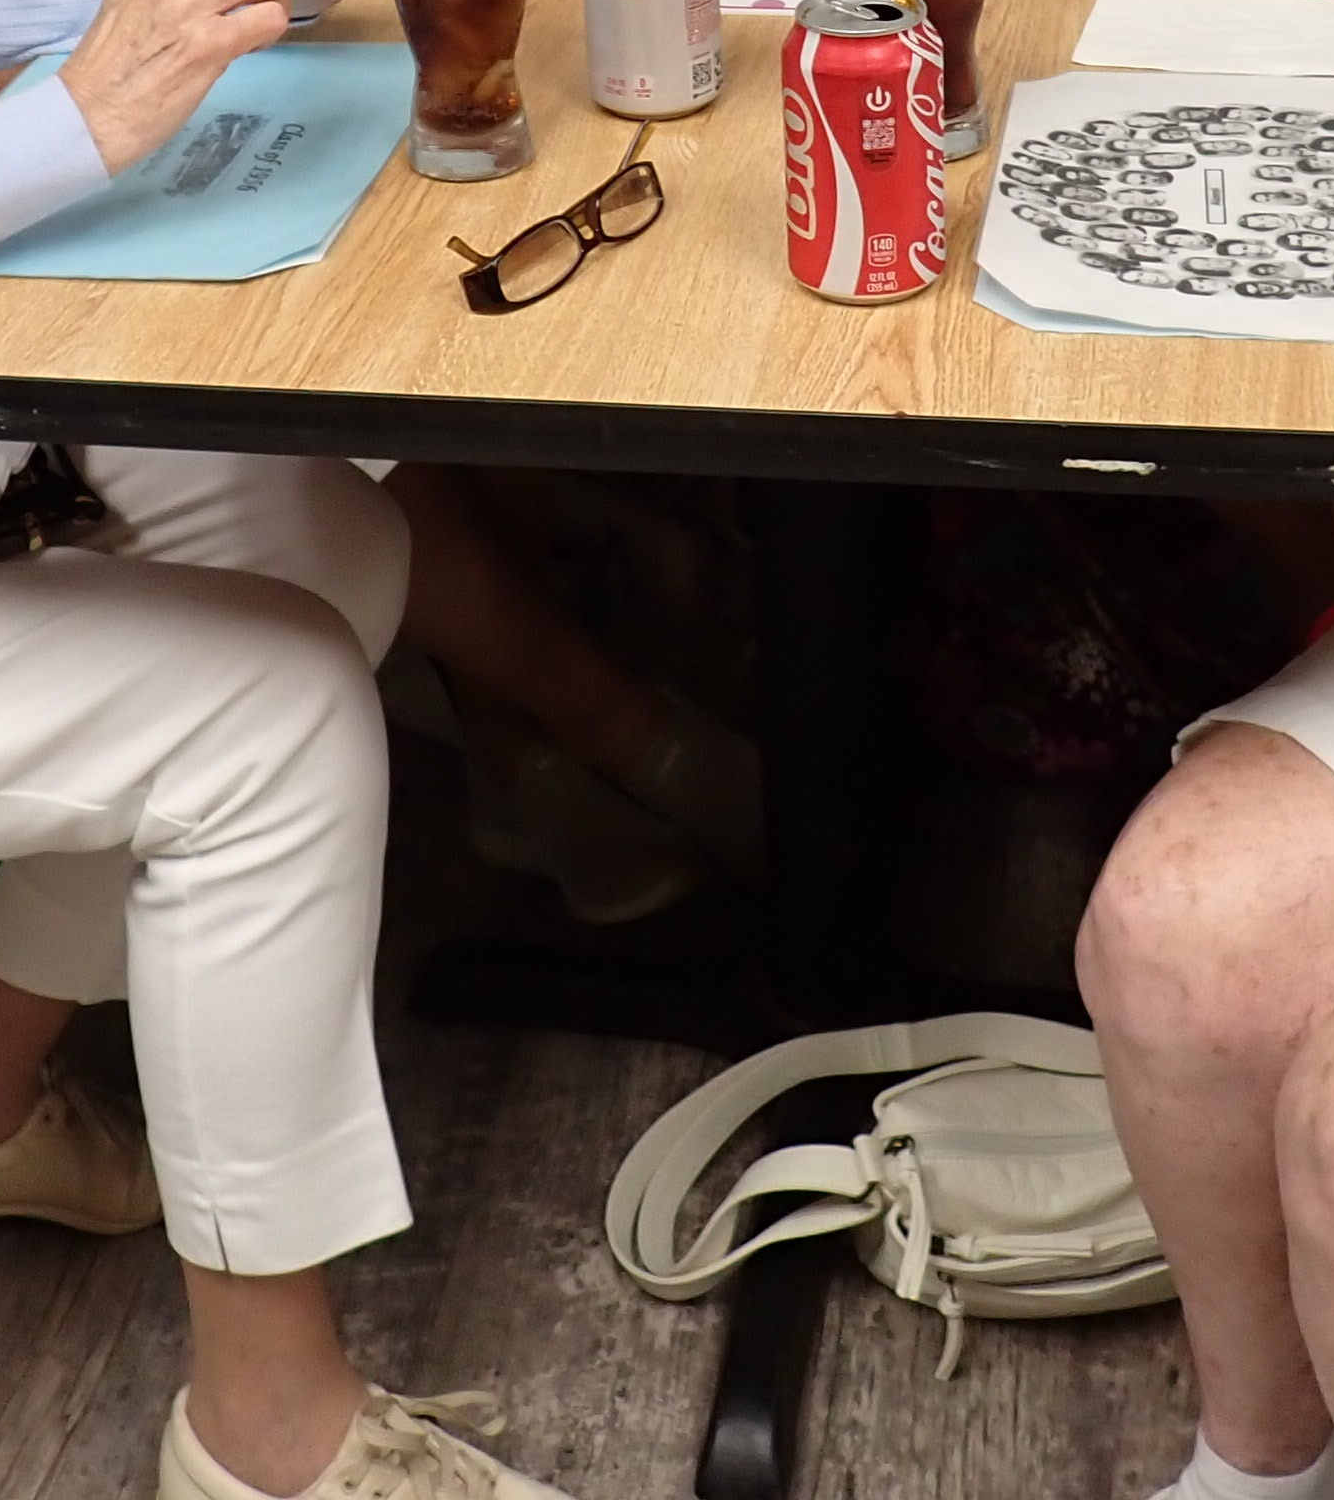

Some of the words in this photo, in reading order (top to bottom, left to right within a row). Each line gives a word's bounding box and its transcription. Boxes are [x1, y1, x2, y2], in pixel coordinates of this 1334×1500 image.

[269, 123, 305, 151] Class
[253, 151, 283, 166] of
[235, 165, 274, 193] 1956
[872, 238, 893, 251] 140
